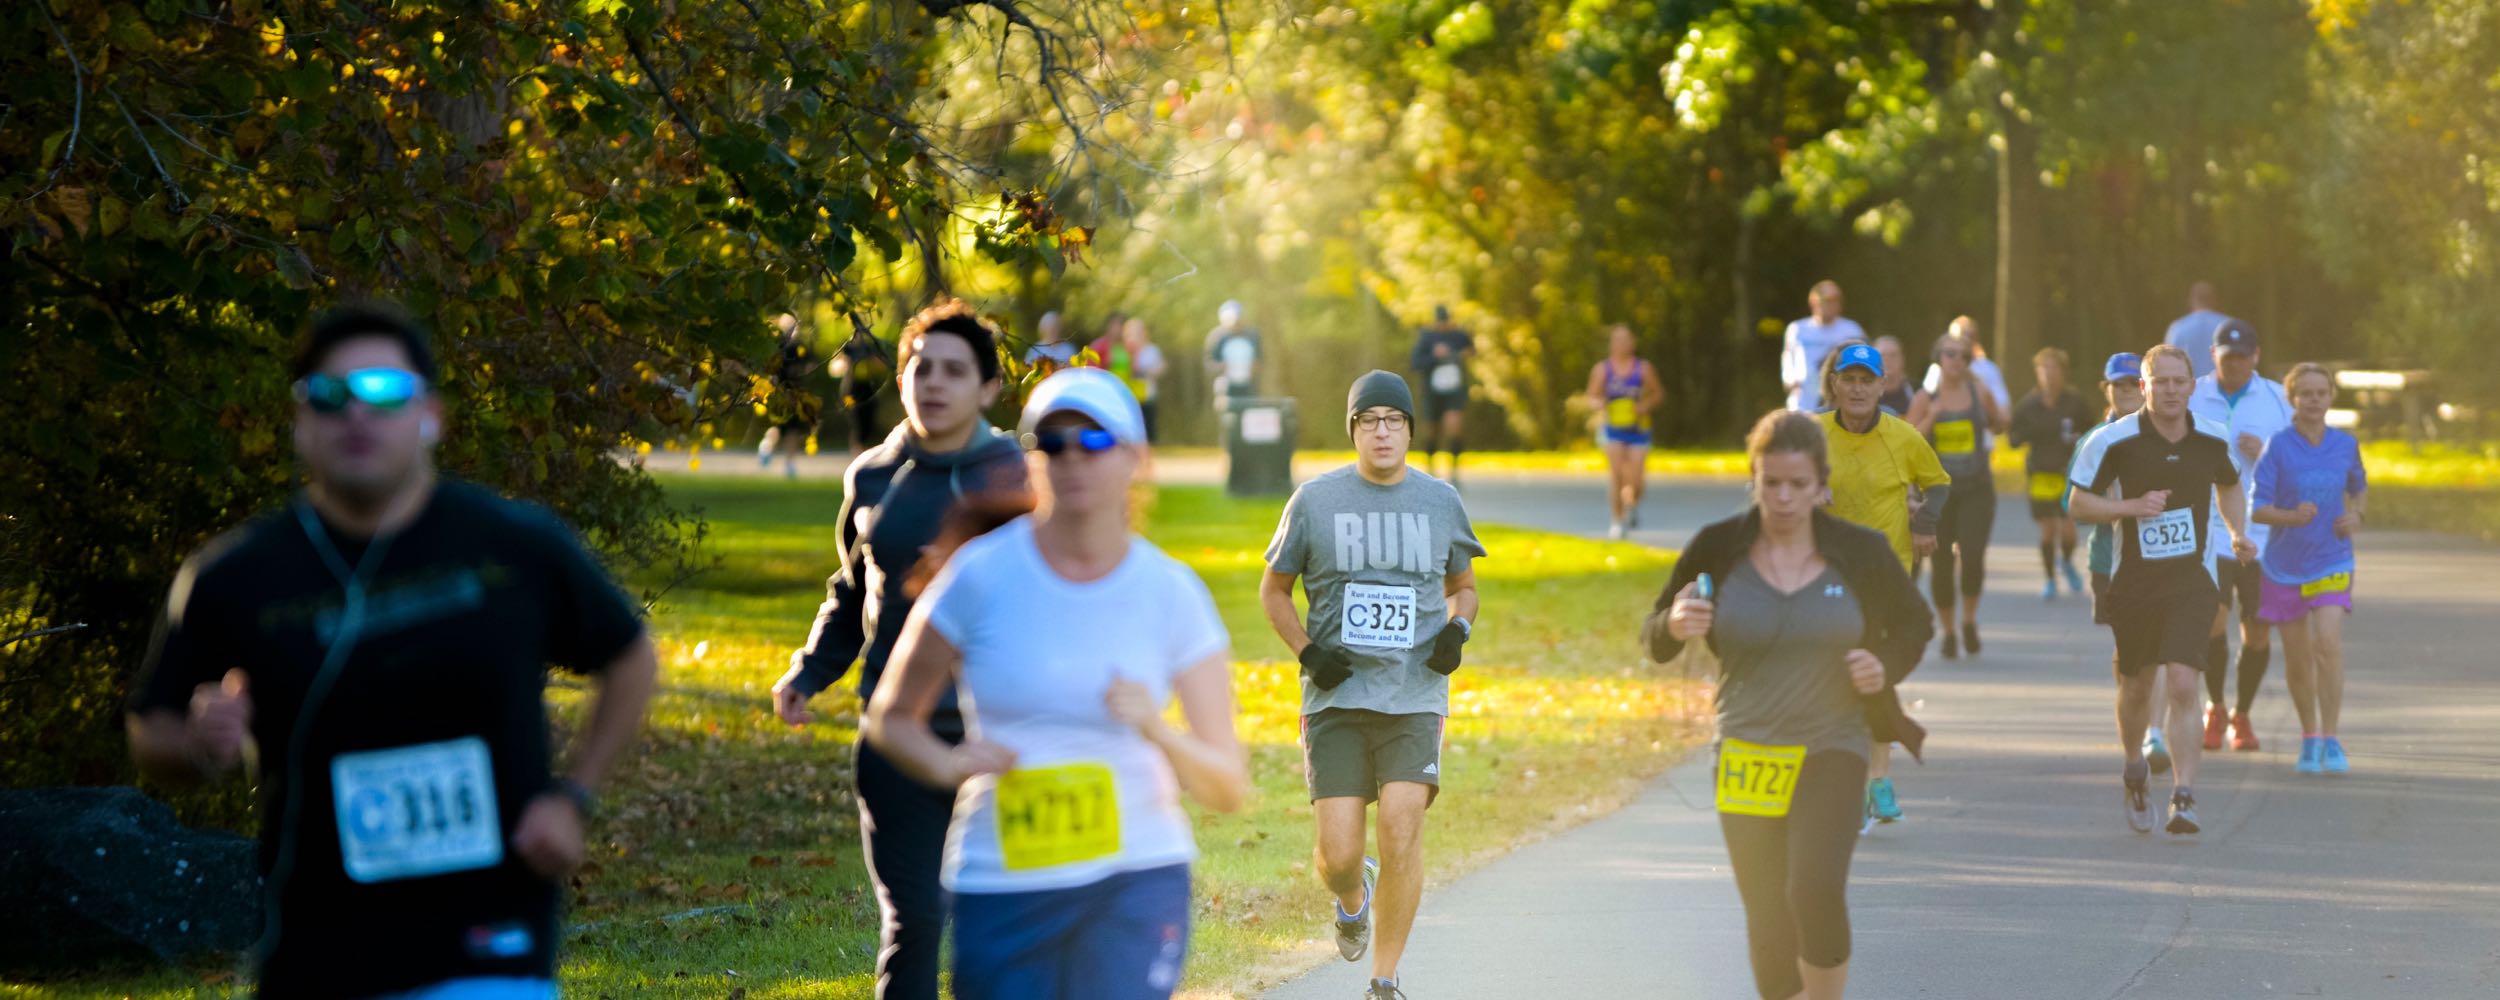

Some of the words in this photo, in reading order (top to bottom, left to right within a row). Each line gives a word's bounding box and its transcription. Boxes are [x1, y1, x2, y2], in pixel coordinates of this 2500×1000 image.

[1334, 512, 1432, 572] RUN
[2142, 521, 2191, 546] C522
[1351, 590, 1365, 598] Run
[1347, 603, 1409, 631] C325
[1348, 631, 1376, 640] Become
[1394, 634, 1408, 642] Run
[1723, 757, 1795, 796] H727
